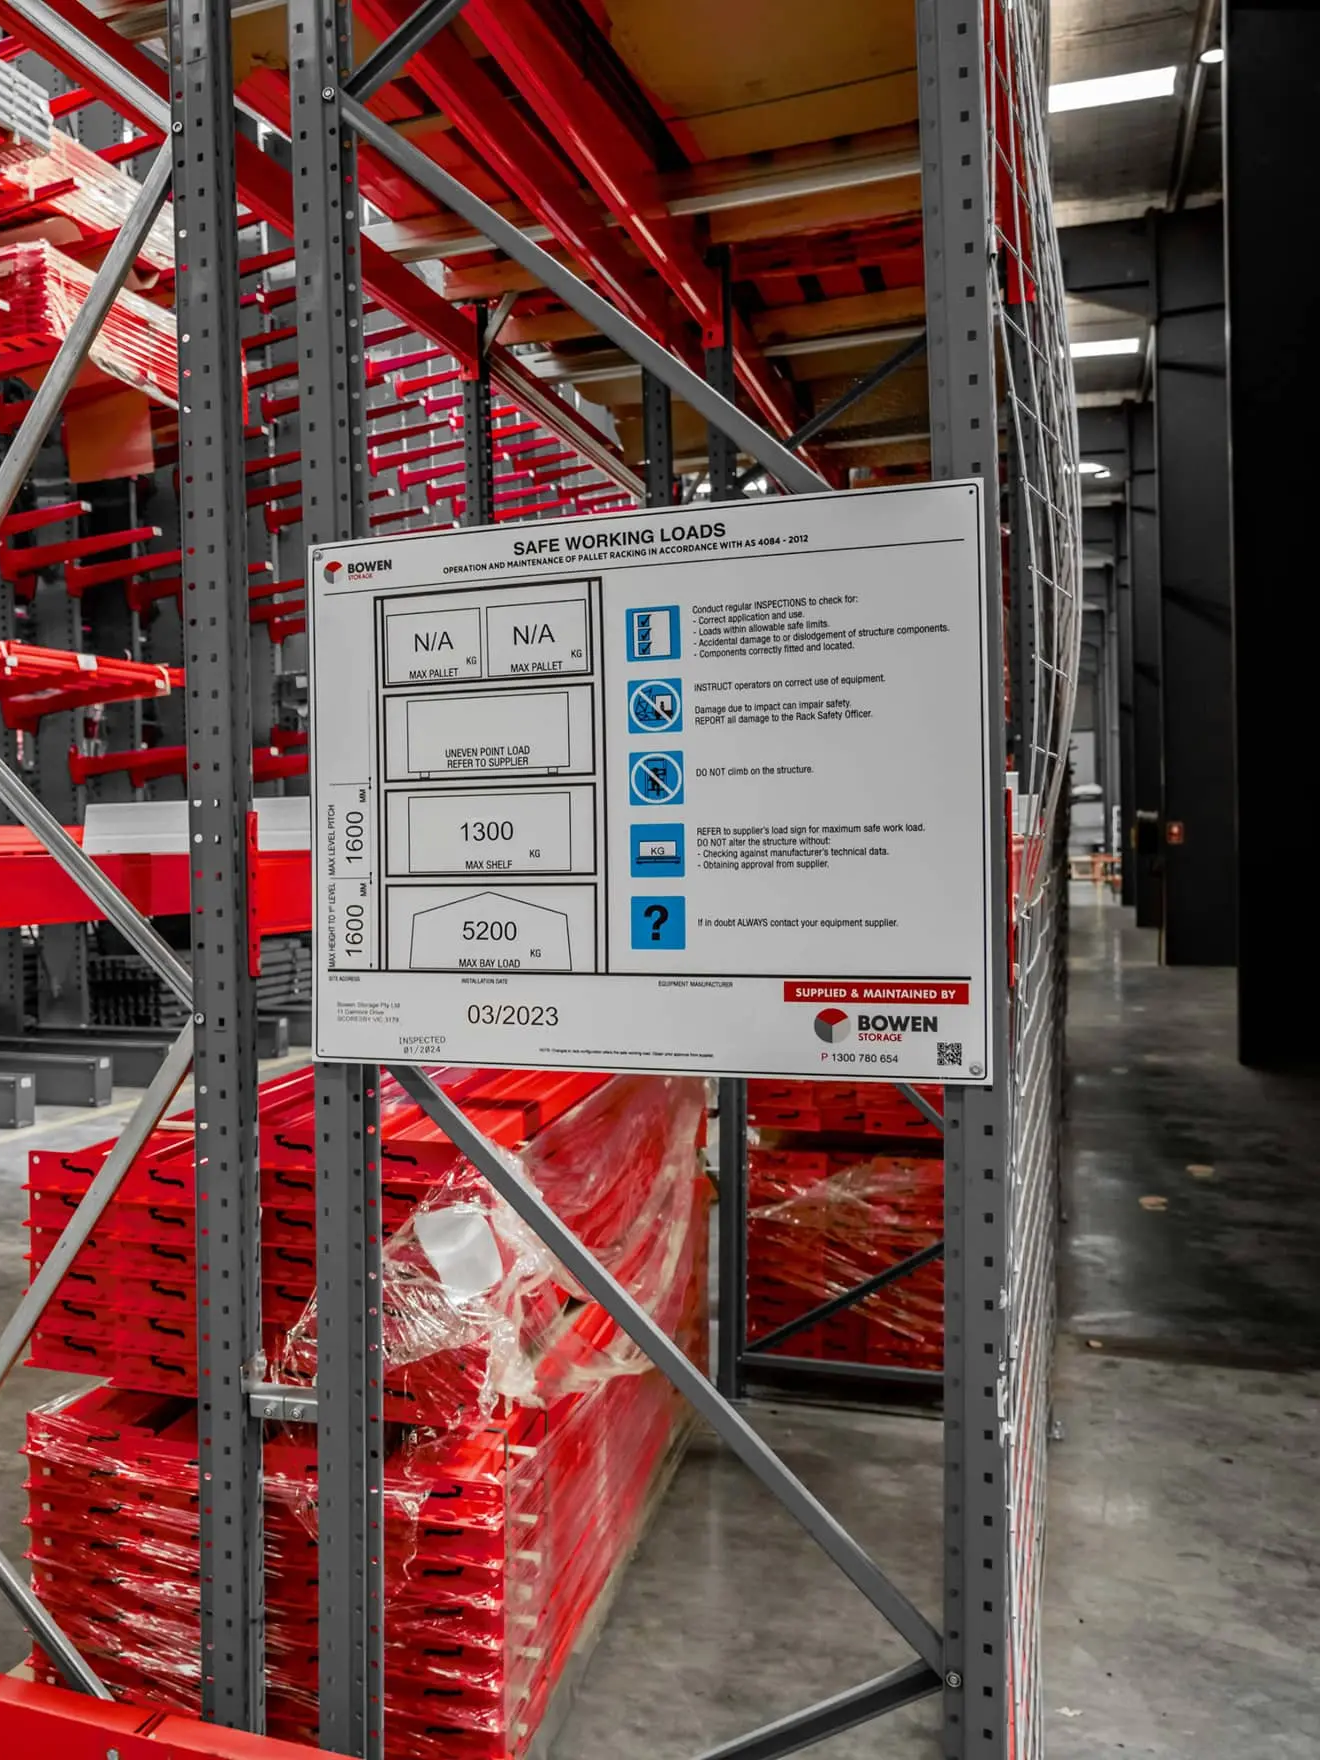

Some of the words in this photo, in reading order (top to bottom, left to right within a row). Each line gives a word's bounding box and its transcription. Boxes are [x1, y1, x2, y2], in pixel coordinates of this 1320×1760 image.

[513, 538, 560, 556] SAFE
[564, 529, 654, 551] WORKING
[660, 522, 726, 542] LOADS
[442, 563, 487, 574] OPERATION
[488, 561, 505, 570] AND
[507, 556, 564, 568] MAINTENANCE
[565, 554, 576, 563] OF
[578, 551, 608, 562] PALLET
[609, 548, 647, 559] RACKING
[648, 547, 657, 555] IN
[658, 542, 718, 554] ACCORDANCE
[719, 540, 743, 549] WITH
[744, 539, 756, 547] AS
[757, 536, 781, 546] 4084
[788, 534, 808, 544] 2012
[347, 559, 392, 574] BOWEN
[692, 604, 723, 614] Conduct
[725, 602, 752, 613] regular
[753, 597, 807, 610] INSPECTIONS
[818, 595, 843, 605] check
[844, 594, 858, 603] for:
[698, 615, 726, 625] Correct
[727, 612, 770, 624] application
[771, 610, 787, 620] and
[788, 610, 805, 619] use.
[513, 623, 555, 646] N/A
[698, 627, 722, 636] Loads
[722, 625, 747, 634] within
[748, 622, 785, 633] allowable
[787, 620, 804, 630] safe
[805, 619, 830, 629] limits.
[414, 631, 454, 652] N/A
[698, 636, 738, 647] Accidental
[739, 635, 771, 645] damage
[792, 629, 846, 642] dislodgement
[858, 627, 895, 637] structure
[896, 623, 950, 635] components.
[570, 649, 582, 658] KG
[699, 647, 747, 658] Components
[748, 645, 782, 655] correctly
[783, 643, 804, 653] fitted
[806, 642, 821, 652] and
[823, 640, 855, 651] located.
[466, 655, 477, 665] KG
[510, 663, 529, 672] MAX
[531, 660, 562, 671] PALLET
[409, 670, 427, 679] MAX
[429, 667, 458, 678] PALLET
[694, 681, 732, 692] INSTRUCT
[734, 680, 771, 691] operators
[784, 677, 813, 687] correct
[814, 678, 829, 686] use
[840, 673, 885, 686] equipment.
[694, 705, 726, 715] Damage
[727, 704, 742, 713] due
[744, 703, 752, 712] to
[754, 702, 781, 712] impact
[782, 702, 797, 710] can
[798, 699, 824, 711] impair
[825, 699, 853, 710] safety.
[694, 713, 725, 725] REPORT
[727, 715, 736, 724] all
[738, 715, 769, 724] damage
[771, 713, 779, 722] to
[781, 712, 794, 722] the
[795, 711, 816, 720] Rack
[817, 710, 842, 720] Safety
[844, 709, 872, 719] Officer.
[445, 747, 477, 758] UNEVEN
[480, 746, 504, 756] POINT
[507, 745, 530, 755] LOAD
[447, 758, 473, 768] REFER
[475, 758, 486, 767] TO
[488, 756, 528, 767] SUPPLIER
[695, 768, 707, 777] DO
[709, 767, 725, 776] NOT
[727, 767, 749, 776] climb
[750, 767, 760, 775] on
[762, 766, 775, 775] the
[776, 765, 814, 774] structure.
[359, 788, 366, 802] MM
[327, 803, 335, 828] PITCH
[344, 810, 364, 864] 1600
[460, 820, 514, 841] 1300
[696, 826, 721, 836] REFER
[723, 827, 731, 835] to
[732, 826, 770, 837] supplier's
[771, 825, 788, 834] load
[790, 825, 807, 836] sign
[808, 825, 820, 834] for
[821, 824, 861, 833] maximum
[863, 823, 880, 832] safe
[882, 823, 903, 832] work
[905, 823, 925, 832] load.
[327, 830, 335, 855] LEVEL
[696, 838, 708, 847] DO
[710, 837, 726, 847] NOT
[728, 838, 746, 846] alter
[747, 837, 760, 846] the
[762, 837, 797, 846] structure
[798, 836, 830, 845] without:
[529, 849, 540, 858] KG
[650, 847, 665, 855] KG
[702, 849, 738, 859] Checking
[739, 849, 768, 859] against
[770, 847, 829, 857] manufacturer's
[830, 847, 867, 856] technical
[868, 847, 889, 856] data.
[328, 857, 336, 875] MAX
[465, 860, 484, 869] MAX
[486, 860, 512, 869] SHELF
[703, 860, 739, 871] Obtaining
[740, 859, 774, 870] approval
[775, 859, 794, 868] from
[796, 859, 829, 870] supplier.
[359, 882, 367, 896] MM
[328, 914, 335, 923] TO
[697, 918, 703, 926] If
[713, 918, 735, 927] doubt
[736, 918, 768, 927] ALWAYS
[769, 918, 799, 927] contact
[800, 919, 818, 928] your
[820, 918, 863, 928] equipment
[864, 918, 898, 928] supplier.
[344, 904, 364, 956] 1600
[462, 920, 517, 941] 5200
[327, 926, 335, 951] HEIGHT
[529, 948, 541, 958] KG
[327, 953, 336, 968] MAX
[458, 959, 478, 969] MAX
[480, 959, 496, 969] BAY
[497, 959, 520, 969] LOAD
[795, 987, 846, 998] SUPPLIED
[850, 988, 859, 998] &
[863, 988, 937, 999] MAINTAINED
[941, 989, 956, 999] BY
[467, 1004, 559, 1026] 03/2023
[857, 1014, 938, 1032] BOWEN
[398, 1035, 446, 1046] INSPECTED
[858, 1032, 902, 1042] STORAGE
[403, 1045, 440, 1054] 01/2024
[821, 1052, 829, 1061] P
[831, 1052, 856, 1062] 1300
[858, 1053, 877, 1063] 780
[879, 1054, 898, 1063] 654
